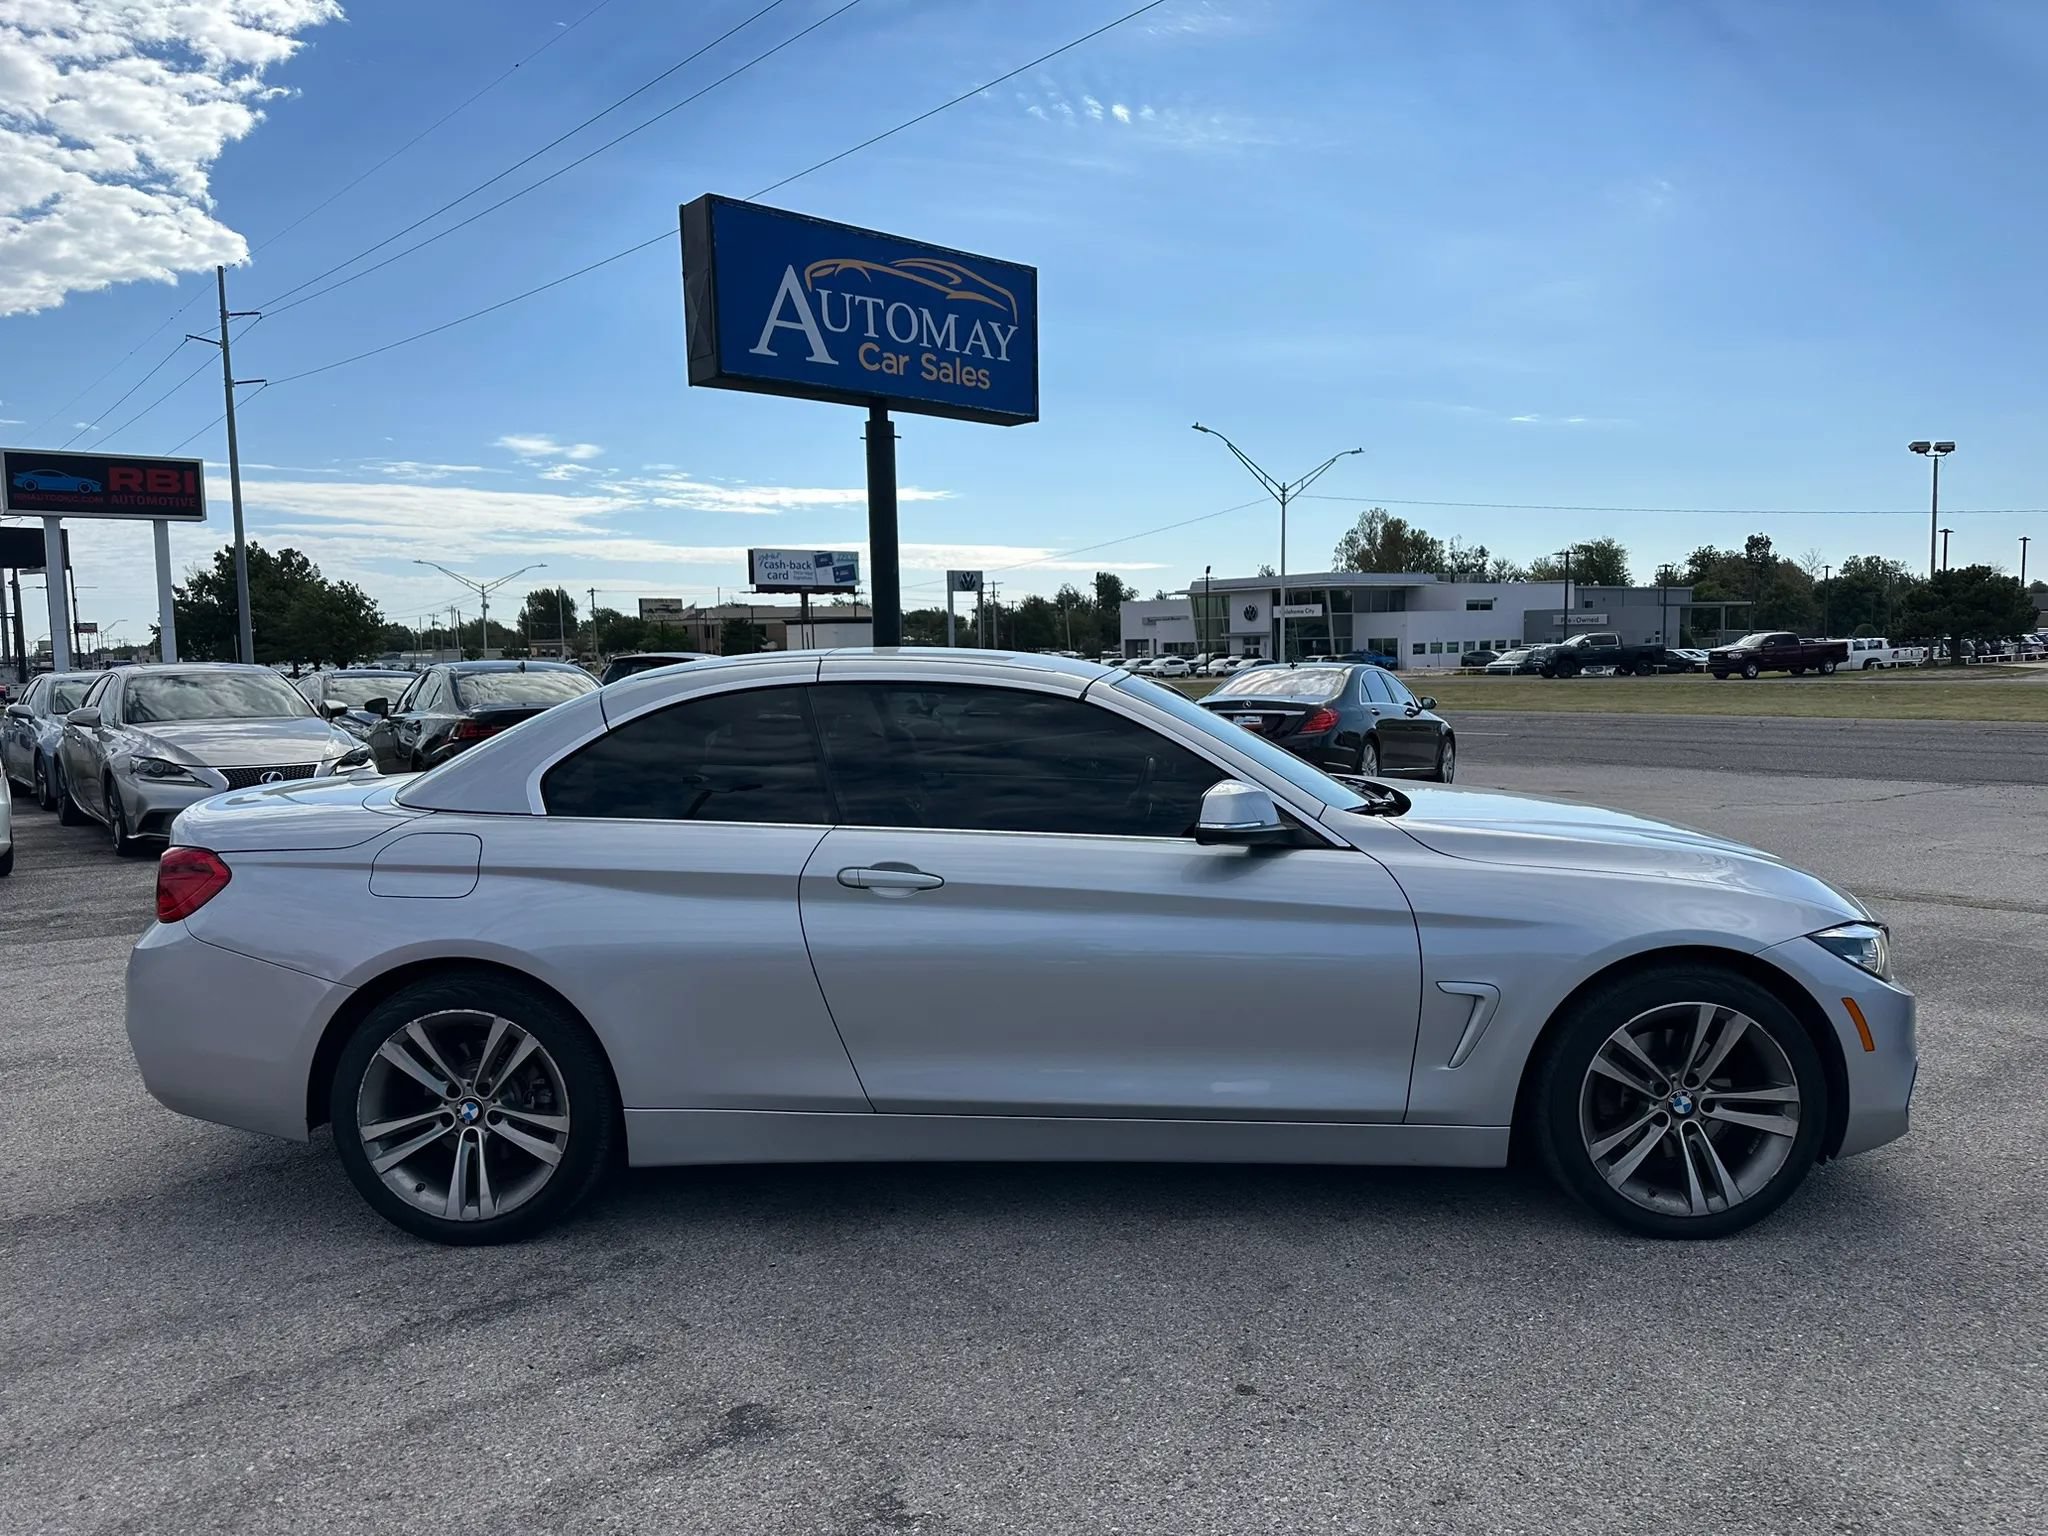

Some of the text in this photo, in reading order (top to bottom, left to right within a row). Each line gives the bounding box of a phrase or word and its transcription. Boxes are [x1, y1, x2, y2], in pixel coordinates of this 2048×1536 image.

[749, 264, 1018, 365] AUTOMAY
[858, 342, 991, 389] Car Sales
[108, 466, 196, 494] RBI
[111, 494, 196, 508] AUTOMOTIVE
[763, 559, 812, 570] cash-back
[767, 570, 789, 580] card
[1560, 616, 1600, 624] Pe-Owned
